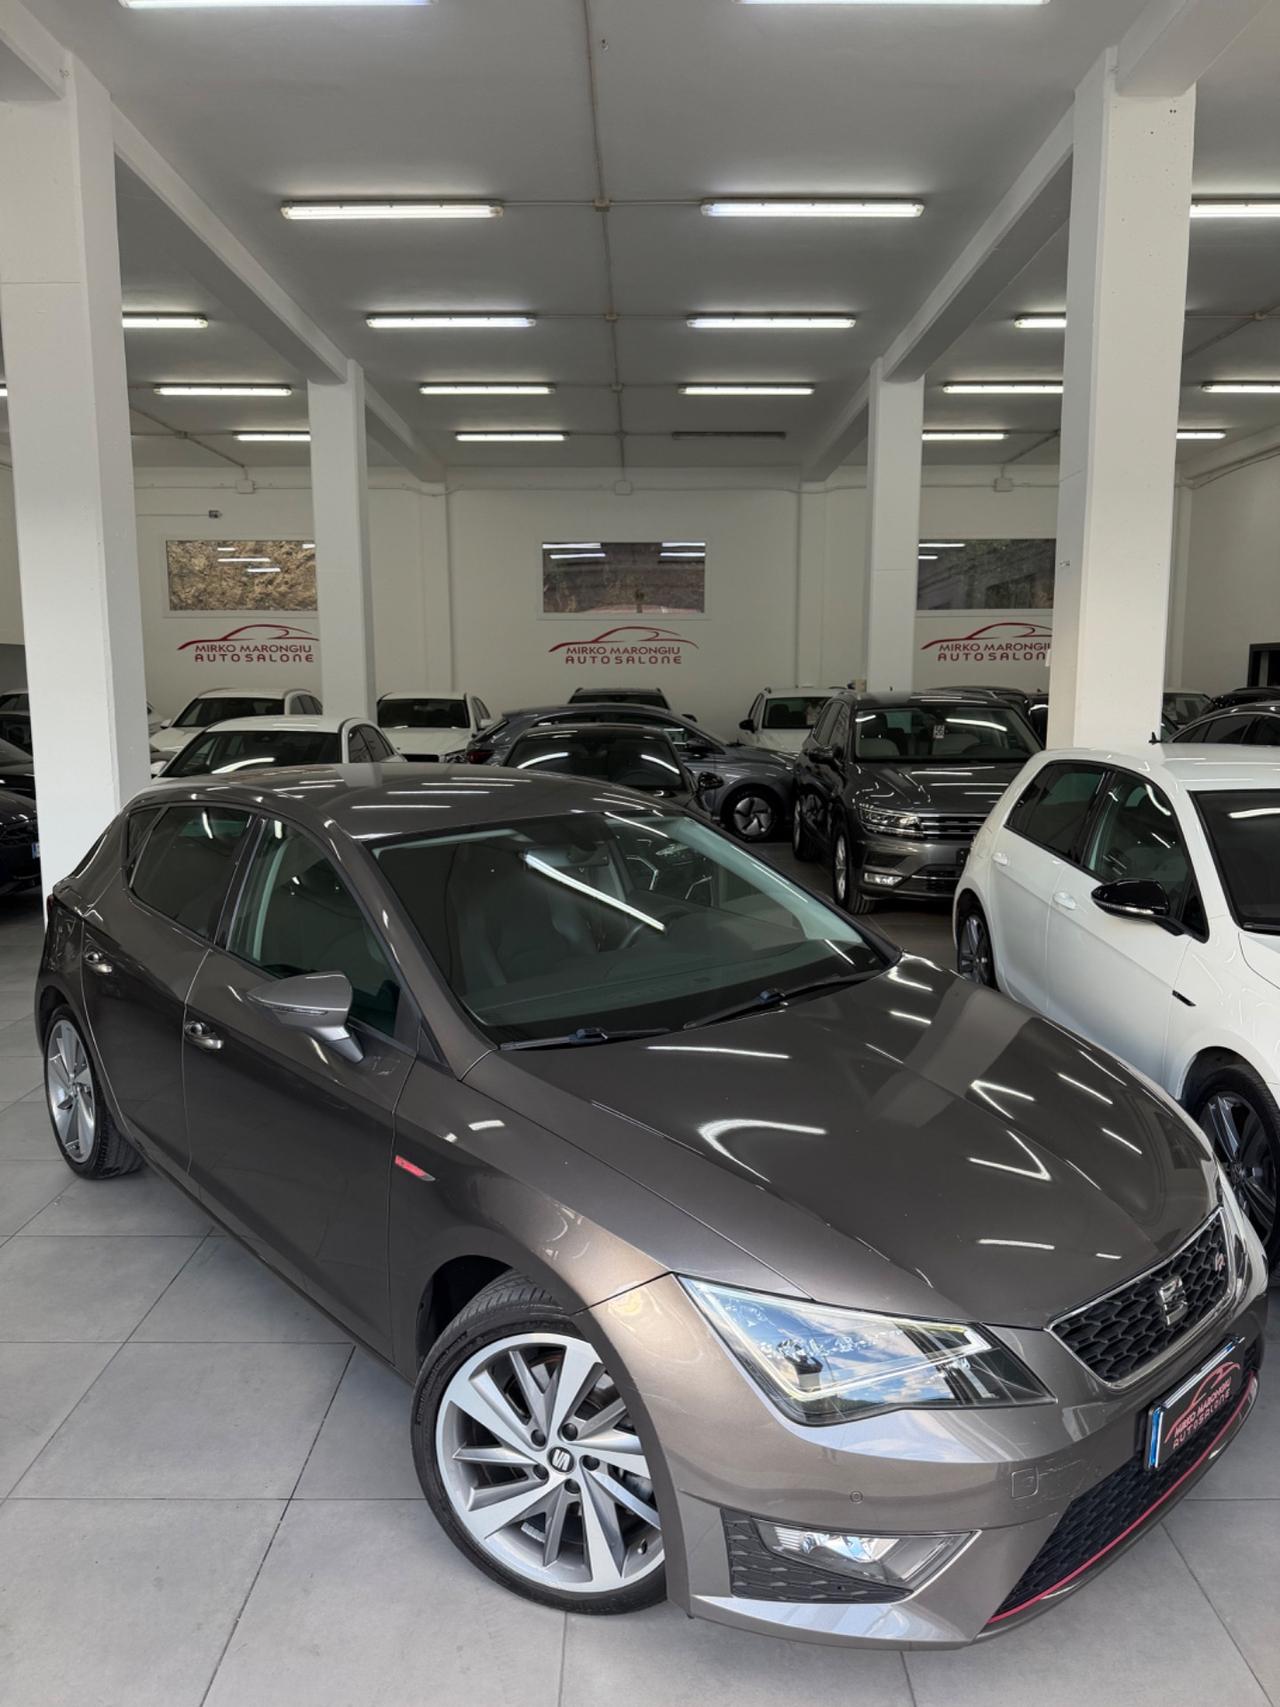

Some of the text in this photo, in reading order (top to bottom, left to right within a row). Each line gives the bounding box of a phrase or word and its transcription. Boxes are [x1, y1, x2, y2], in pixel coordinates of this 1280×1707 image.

[195, 644, 312, 653] MIRKO MARONGIU
[566, 646, 681, 655] MIRKO MARONGIU
[939, 643, 981, 652] MIRKO
[195, 653, 314, 663] AUTOSALONE
[565, 656, 682, 665] AUTOSALONE
[937, 652, 1046, 662] AUTOSALON
